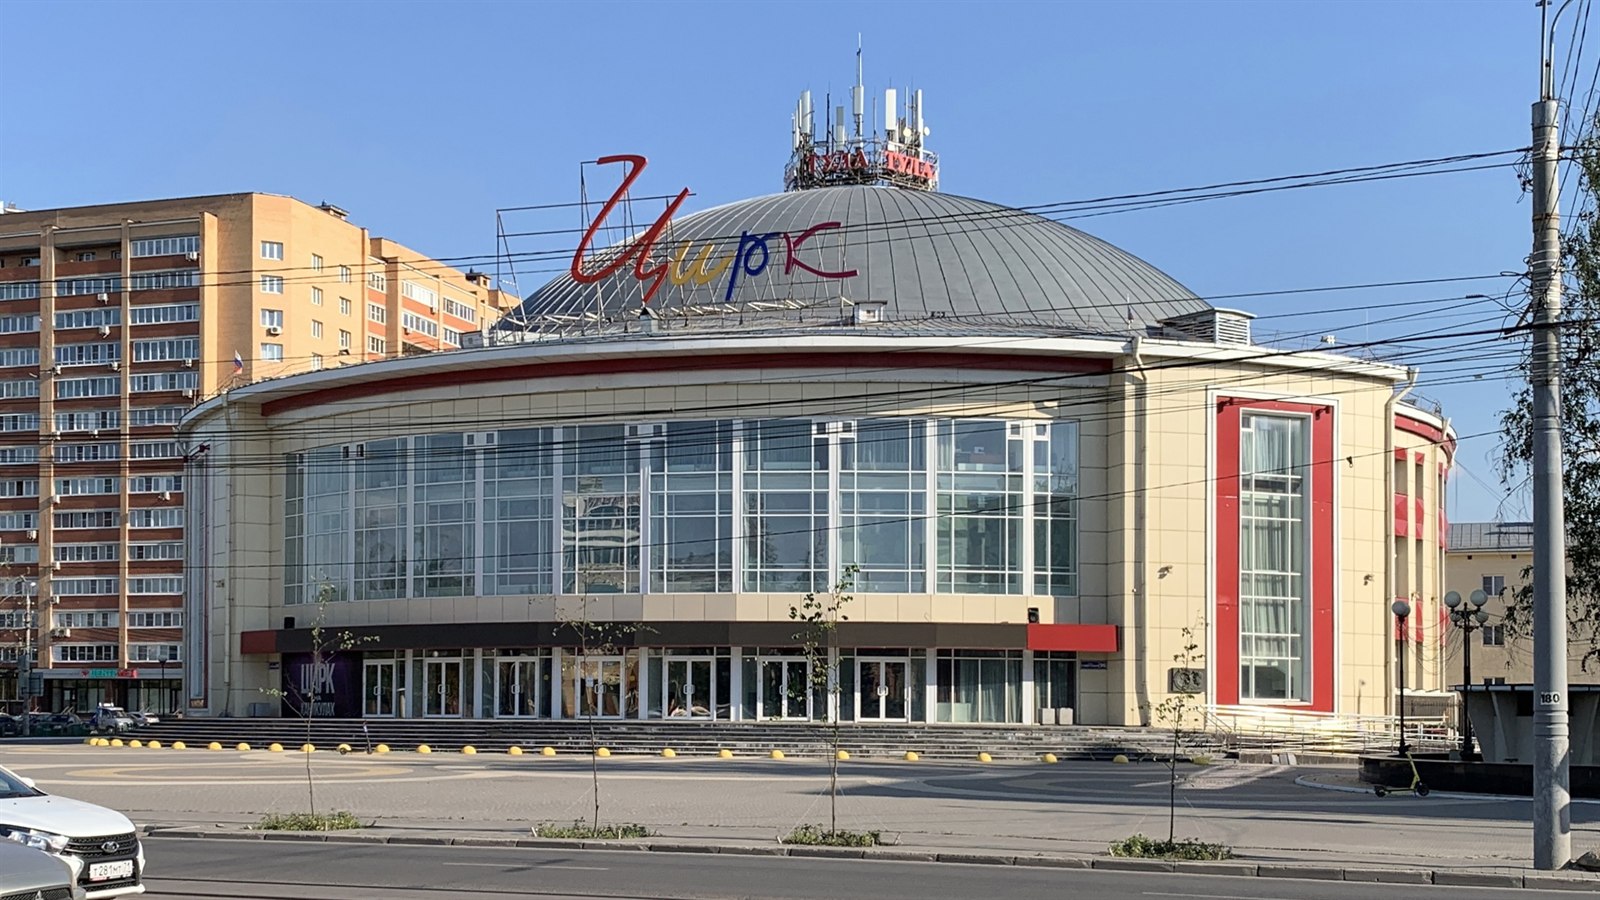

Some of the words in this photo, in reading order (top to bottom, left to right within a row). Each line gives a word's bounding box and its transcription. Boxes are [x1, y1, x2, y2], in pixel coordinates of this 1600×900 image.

[885, 150, 936, 179] ТУЛА
[571, 154, 859, 302] Цирк
[1541, 694, 1560, 703] 180
